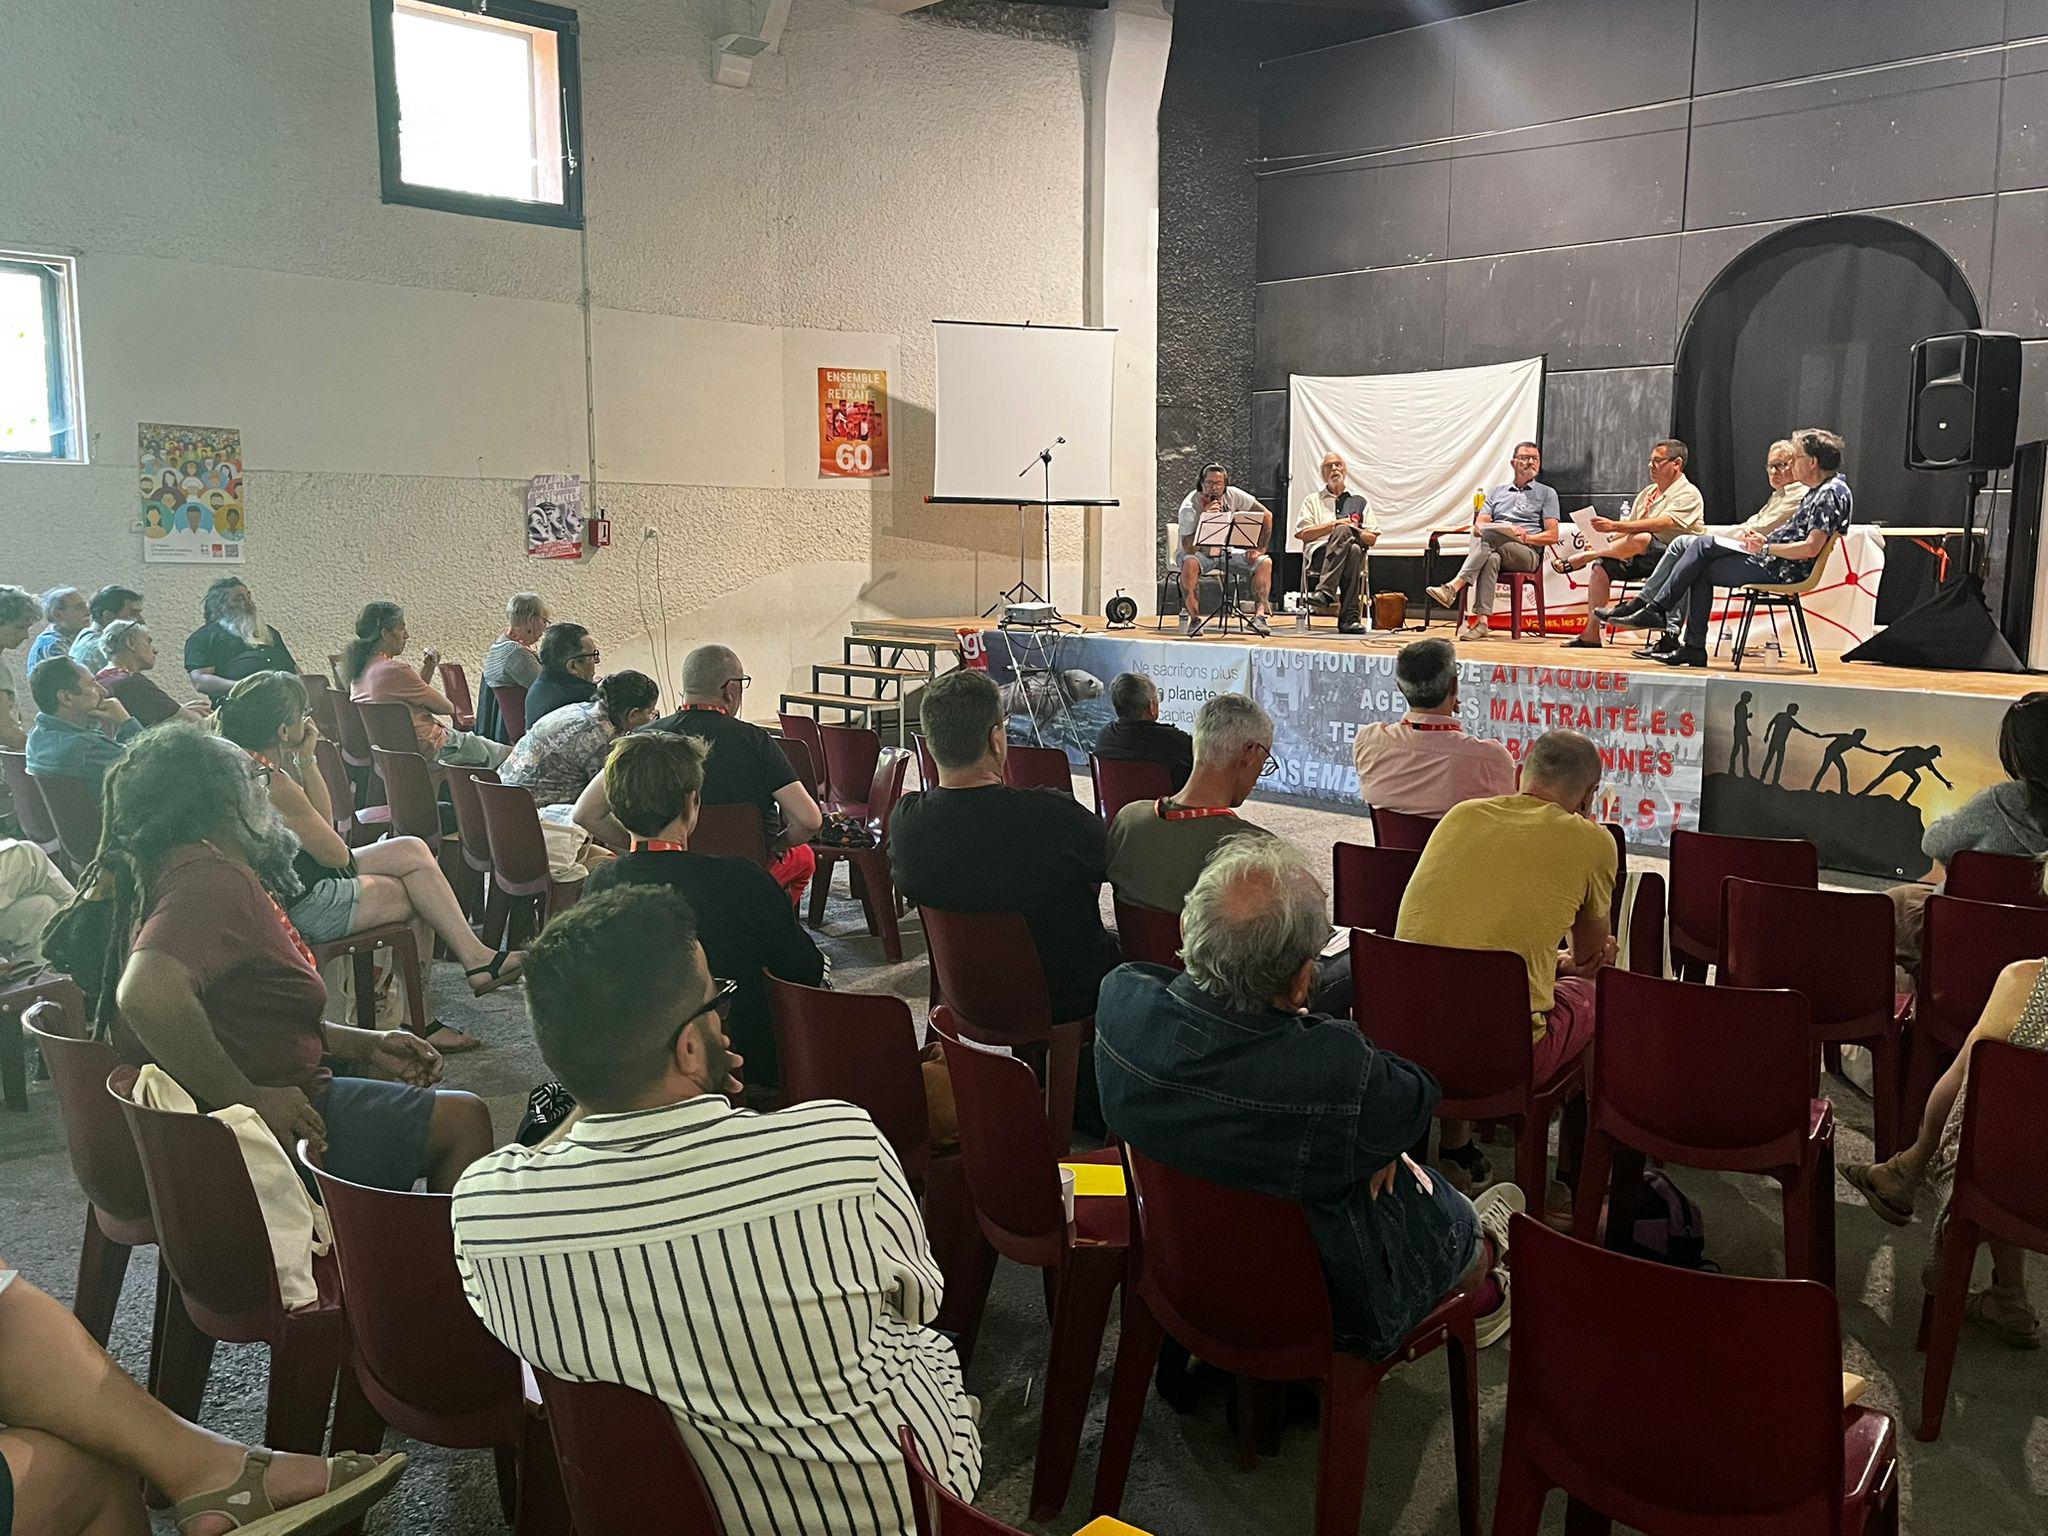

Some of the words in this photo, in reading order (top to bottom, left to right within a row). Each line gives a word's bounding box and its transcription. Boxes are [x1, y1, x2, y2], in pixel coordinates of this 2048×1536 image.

[826, 371, 880, 384] ENSEMBLE
[828, 388, 876, 401] RETRAITE
[835, 443, 873, 470] 60
[1561, 617, 1575, 627] les
[1576, 616, 1588, 626] 27
[1251, 650, 1355, 674] FONCTION
[1132, 660, 1150, 677] Ne
[1153, 662, 1208, 679] sacrifions
[1211, 668, 1240, 682] plus
[1168, 685, 1218, 702] planète
